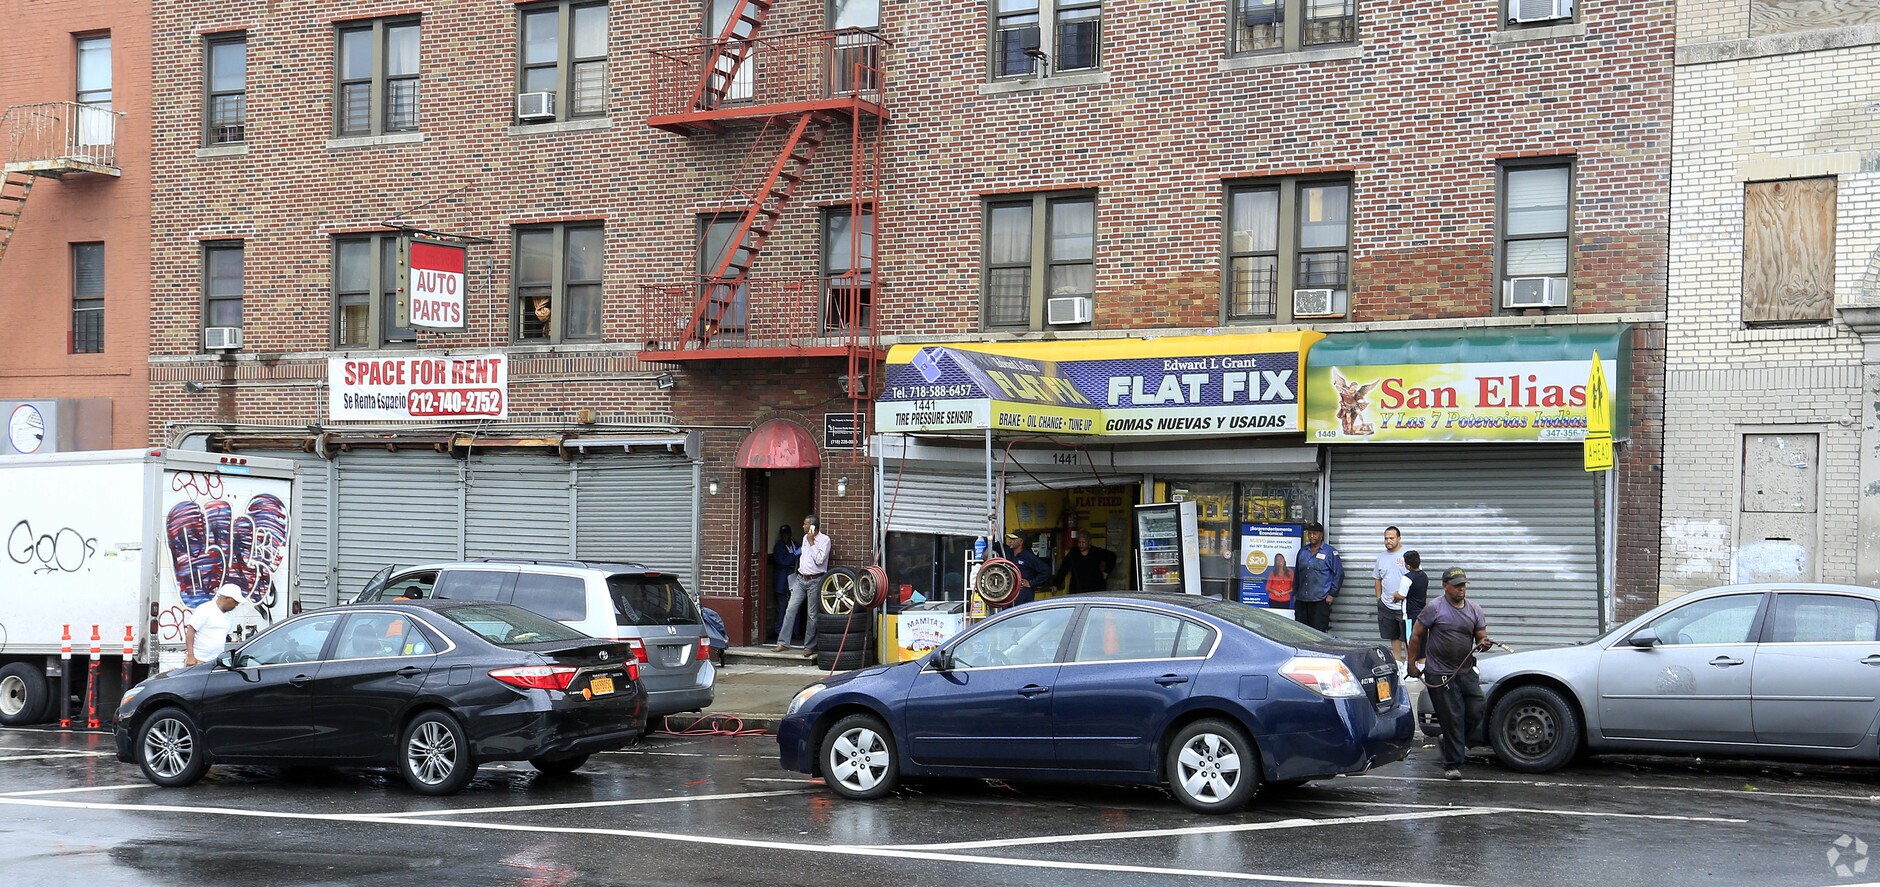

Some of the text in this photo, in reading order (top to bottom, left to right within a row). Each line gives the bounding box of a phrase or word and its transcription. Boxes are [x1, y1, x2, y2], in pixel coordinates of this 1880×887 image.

[417, 271, 457, 295] AUTO
[413, 299, 460, 323] PARTS
[344, 359, 502, 385] SPACE FOR RENT
[1163, 357, 1257, 371] Edward L Grant
[892, 384, 972, 399] Tel. 718-588-6457
[985, 370, 1092, 404] FLAT FIX
[1107, 369, 1295, 406] FLAT FIX
[1380, 374, 1586, 409] San Elias
[344, 391, 500, 413] Se Renta Espacio 212-740-2752
[914, 400, 936, 411] 1441
[896, 411, 973, 426] TIRE PRESSURE SENSOR
[998, 413, 1021, 427] BRAKE
[1027, 415, 1037, 427] OIL
[1039, 416, 1063, 429] CHANGE
[1069, 418, 1083, 430] TUNE
[1084, 420, 1092, 431] UP
[1105, 415, 1286, 431] GOMAS NUEVAS Y USADAS
[1380, 409, 1587, 429] Y Las 7 Potencias Indias
[1317, 430, 1336, 438] 1449
[1053, 453, 1077, 465] 1441
[1589, 442, 1609, 461] AHEAD
[1249, 556, 1266, 565] $20
[907, 617, 945, 629] MAMITA'S
